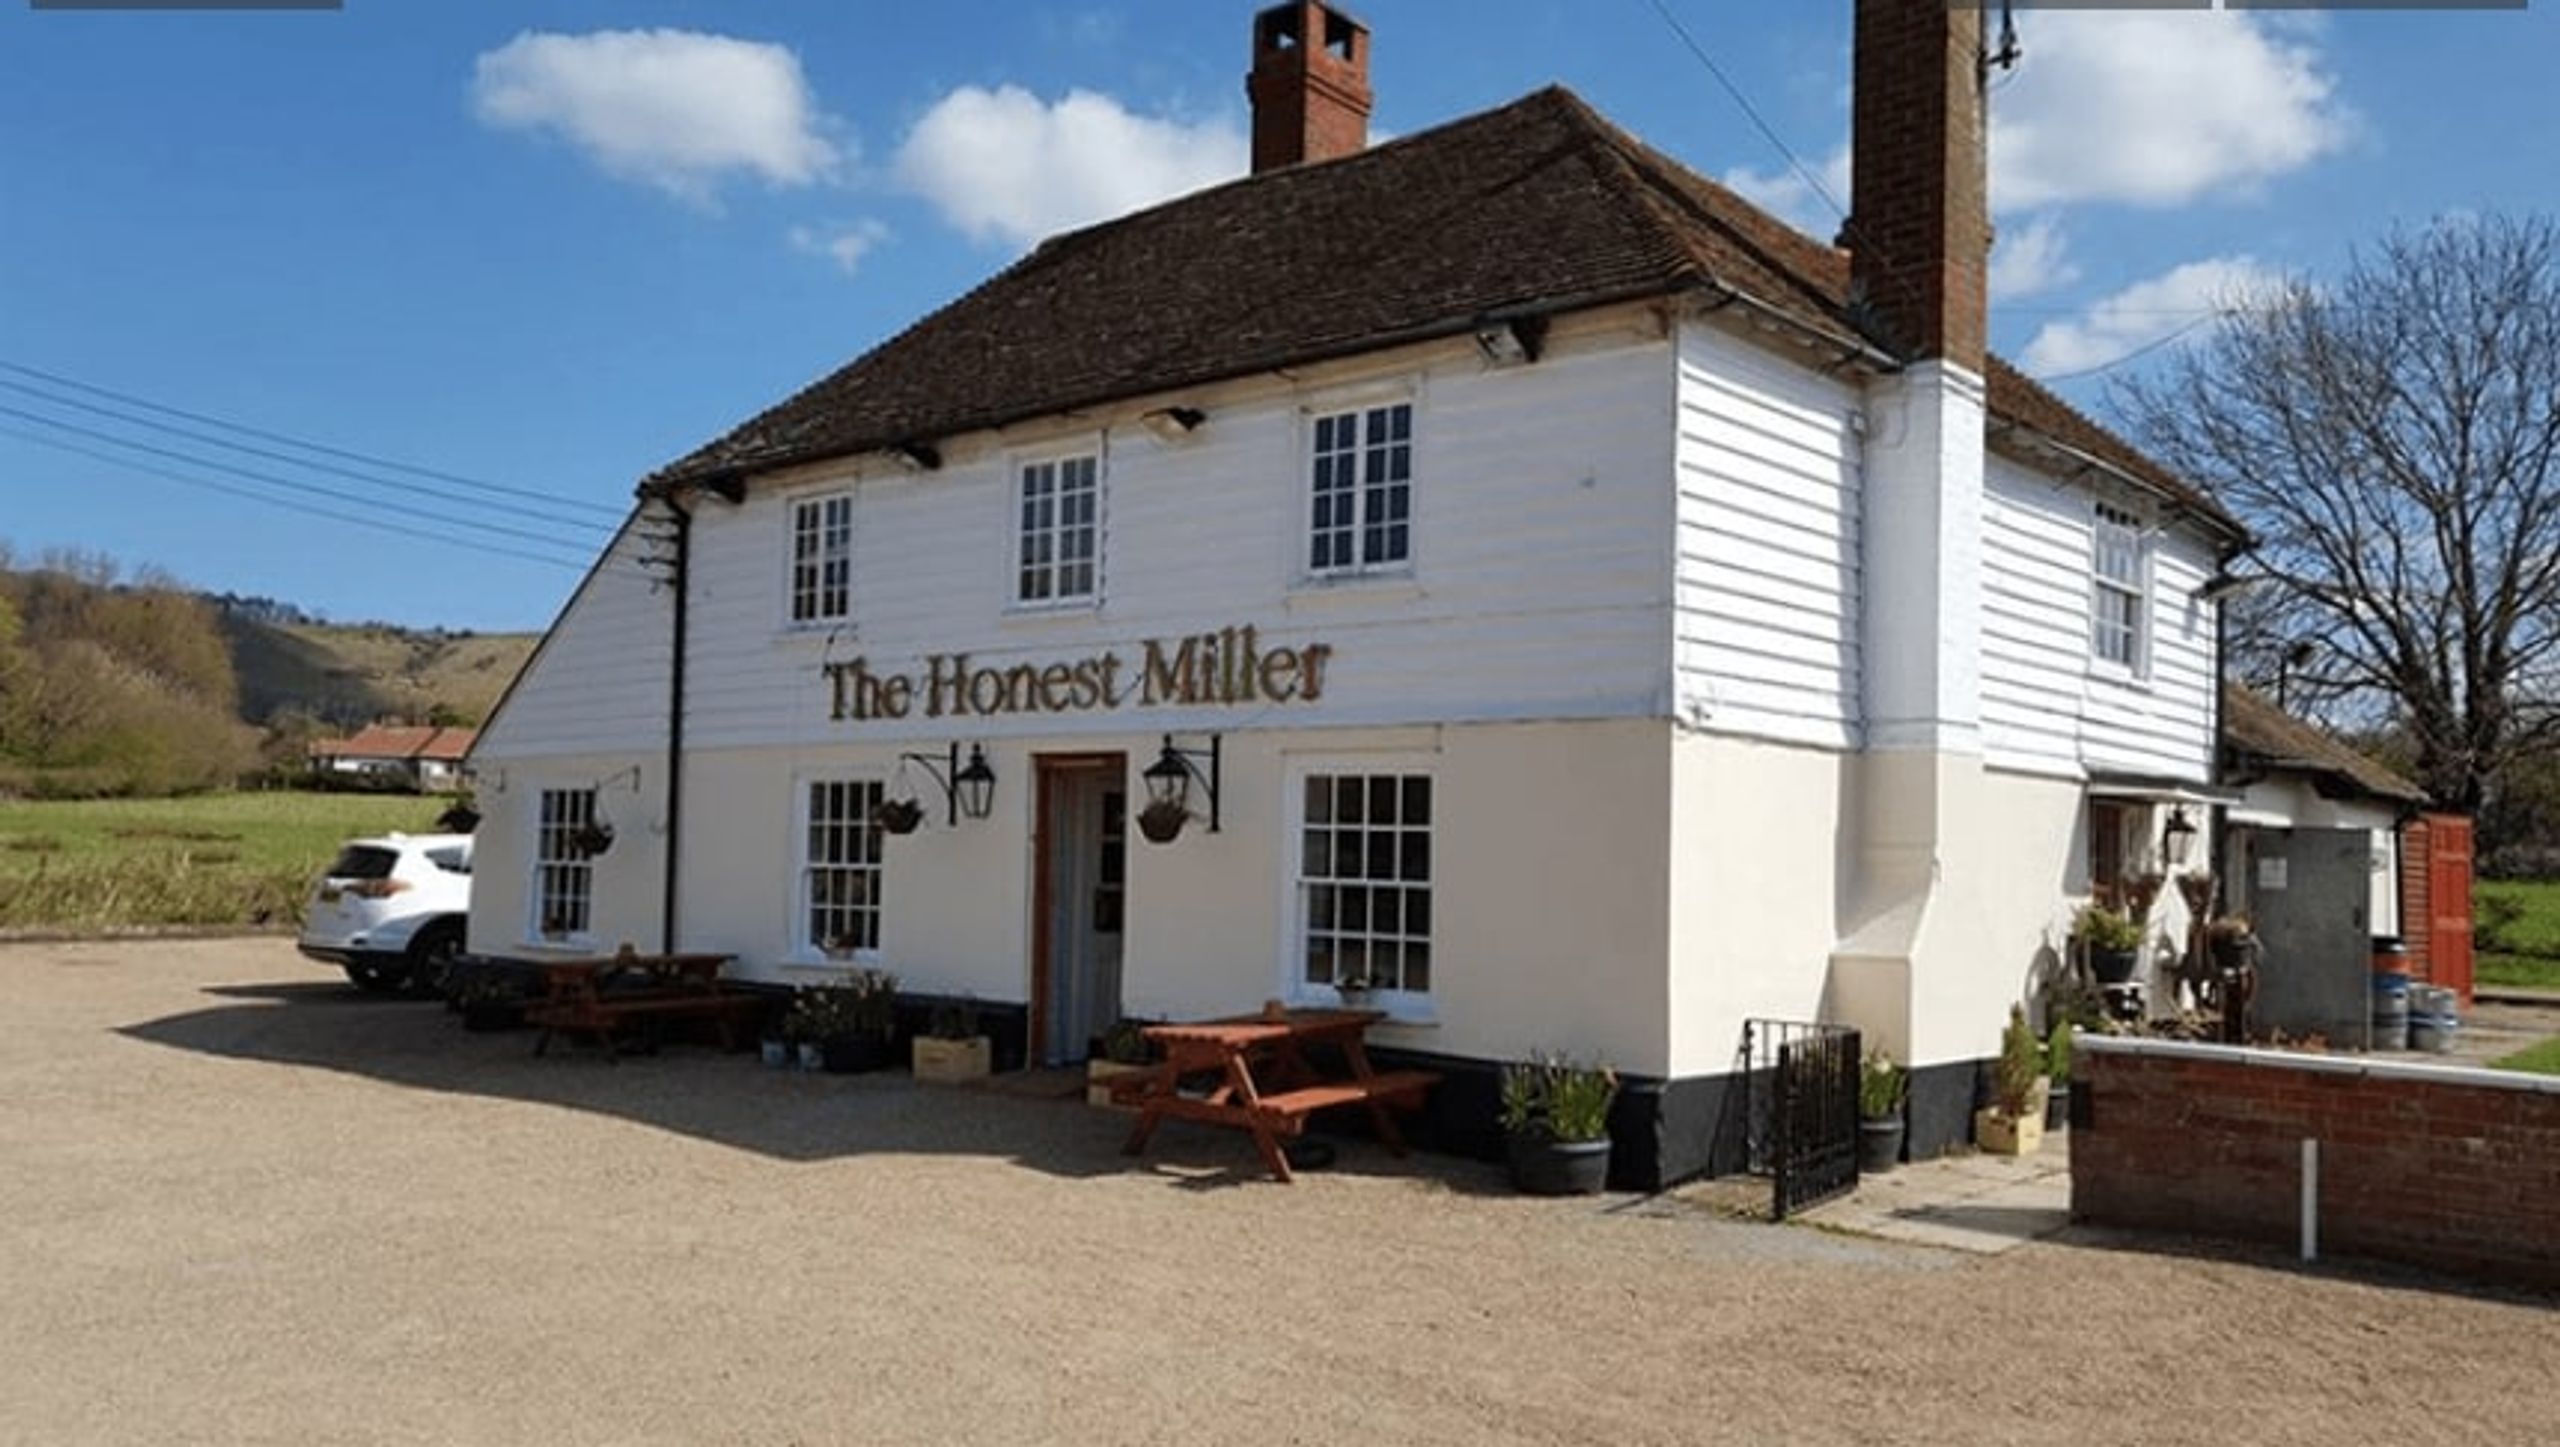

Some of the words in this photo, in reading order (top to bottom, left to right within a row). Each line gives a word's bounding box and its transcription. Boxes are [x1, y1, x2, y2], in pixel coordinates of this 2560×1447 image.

[828, 656, 911, 721] The
[924, 651, 1122, 718] Honest
[1141, 623, 1332, 707] Miller
